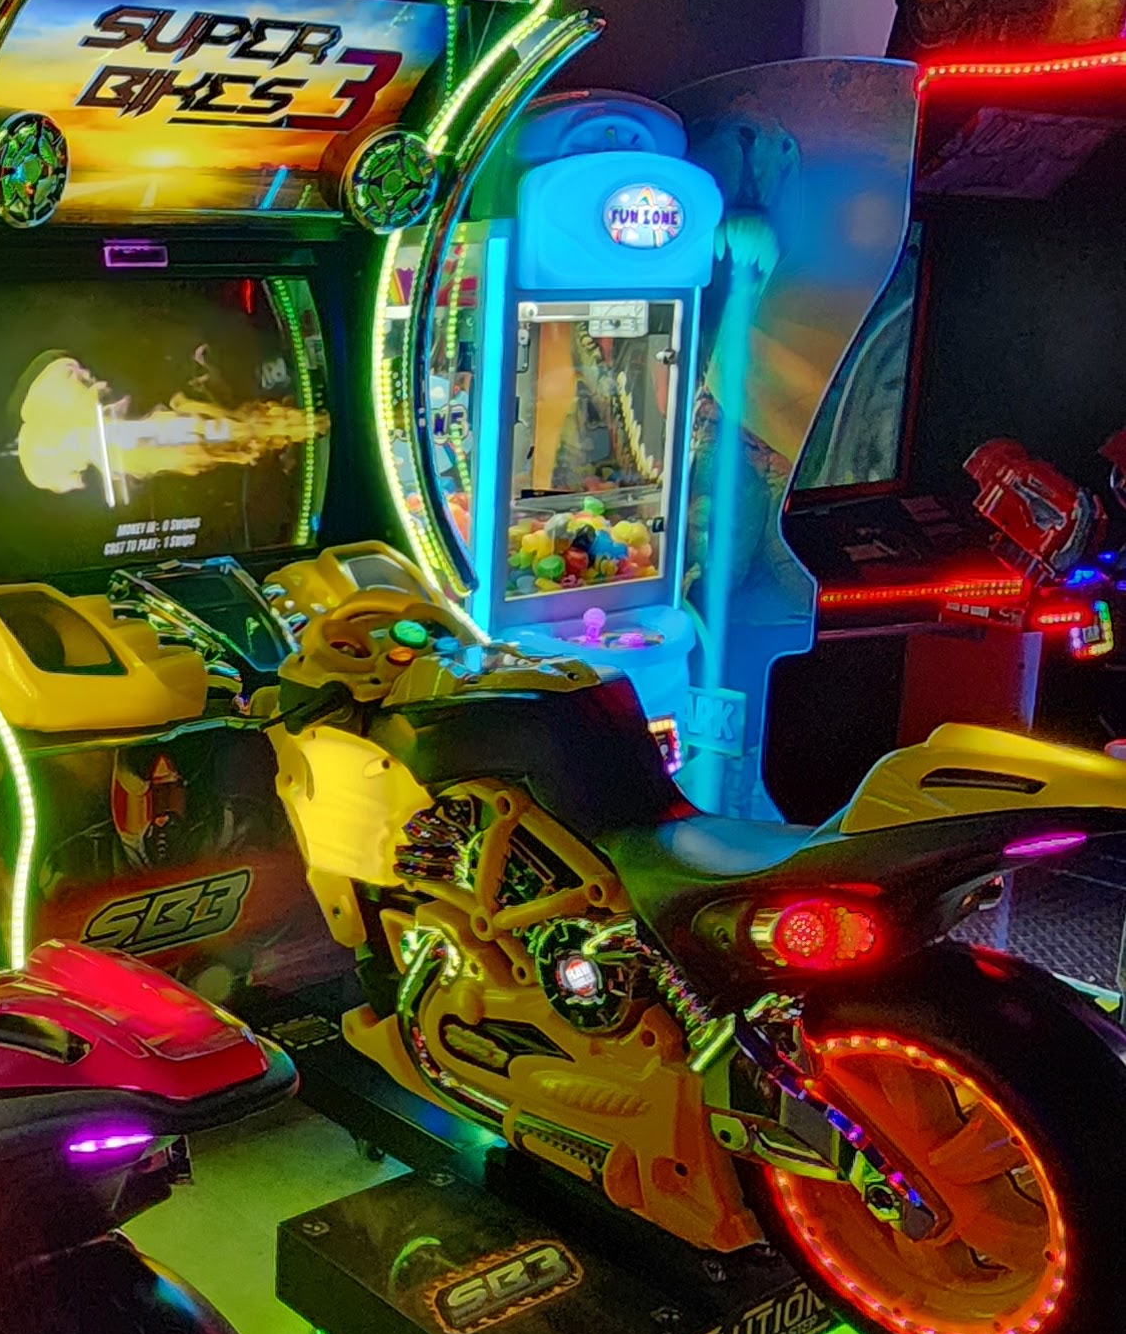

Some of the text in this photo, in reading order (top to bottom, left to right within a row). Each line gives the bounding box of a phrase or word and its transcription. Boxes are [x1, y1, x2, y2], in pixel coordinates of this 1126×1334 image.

[77, 4, 344, 70] SUPER
[73, 46, 404, 135] BIKES 3
[446, 1246, 568, 1328] SB3
